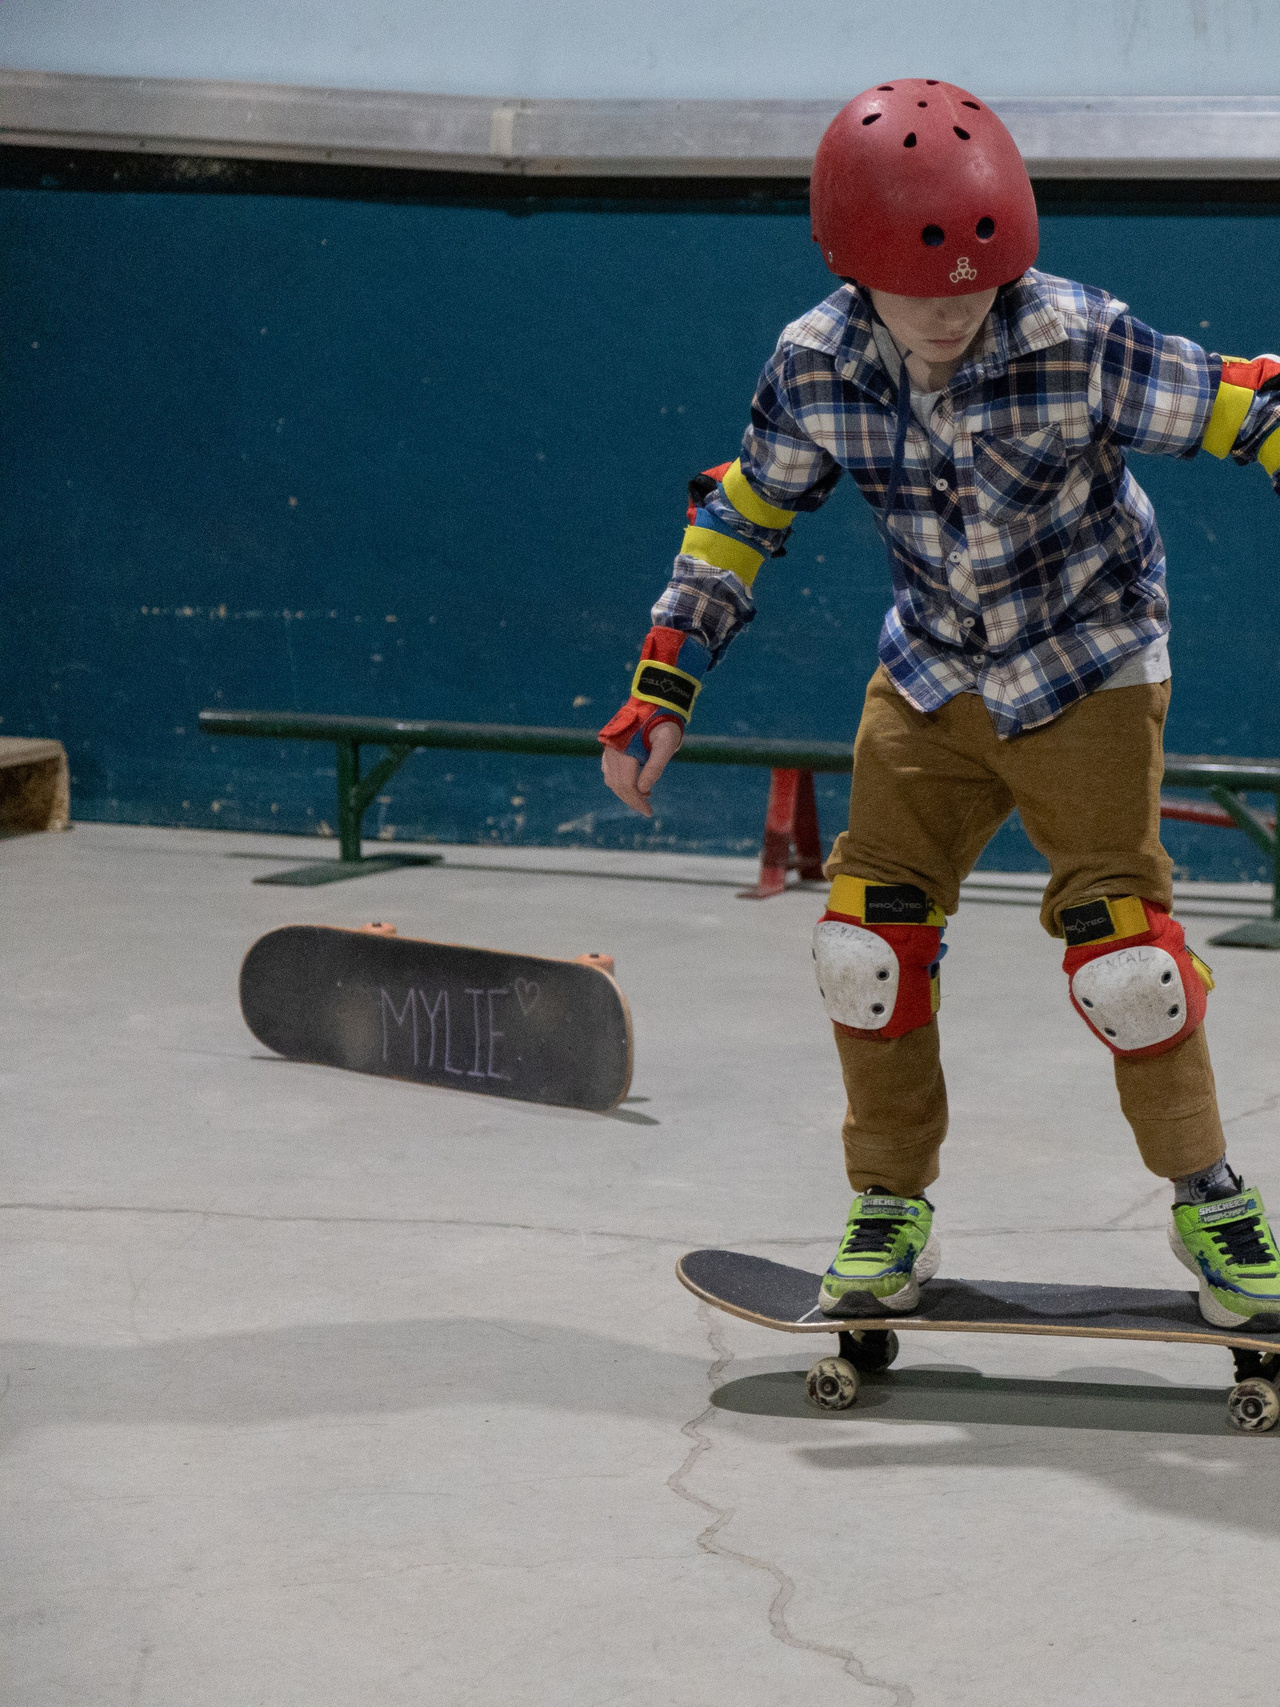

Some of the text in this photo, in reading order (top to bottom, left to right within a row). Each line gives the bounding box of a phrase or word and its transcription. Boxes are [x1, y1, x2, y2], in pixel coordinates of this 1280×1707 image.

[868, 902, 892, 910] PRO
[1084, 916, 1107, 927] TEC
[379, 986, 513, 1082] MYLIE
[862, 1198, 907, 1208] SKECHERS
[1198, 1198, 1246, 1216] SKECHERS
